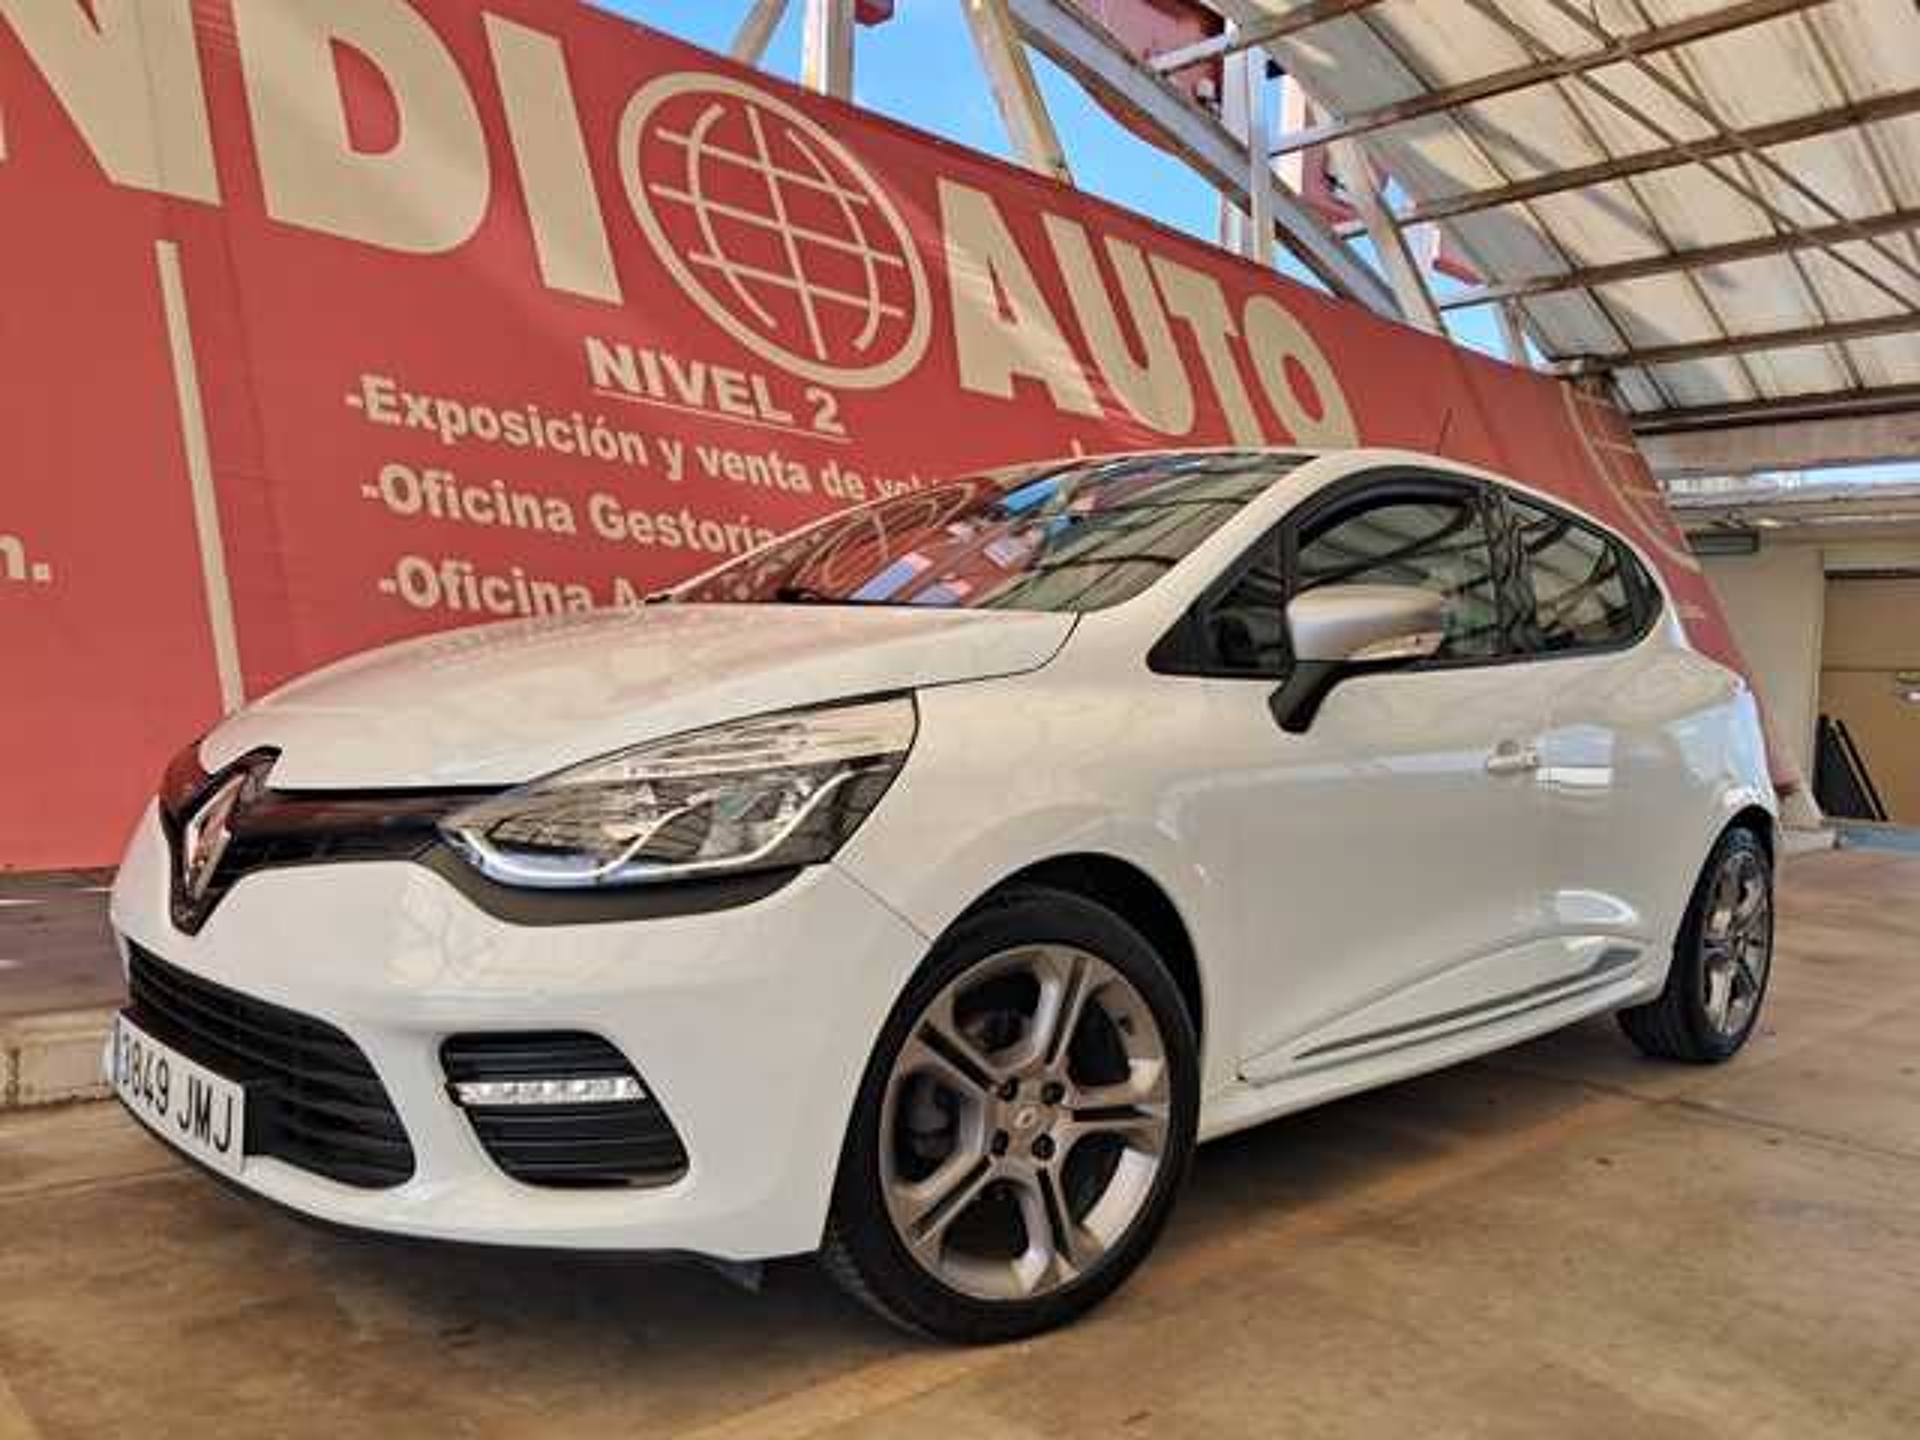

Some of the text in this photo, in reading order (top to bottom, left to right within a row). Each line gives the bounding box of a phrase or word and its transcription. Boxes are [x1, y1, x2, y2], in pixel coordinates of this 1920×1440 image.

[937, 176, 1361, 449] AUTO
[585, 336, 846, 434] NIVEL 2
[345, 373, 649, 466] -Exposición
[656, 437, 684, 481] y
[695, 444, 812, 493] venta
[821, 459, 866, 500] de
[361, 463, 577, 534] -Oficina
[378, 554, 595, 616] -Oficina
[176, 1074, 233, 1152] JMJ
